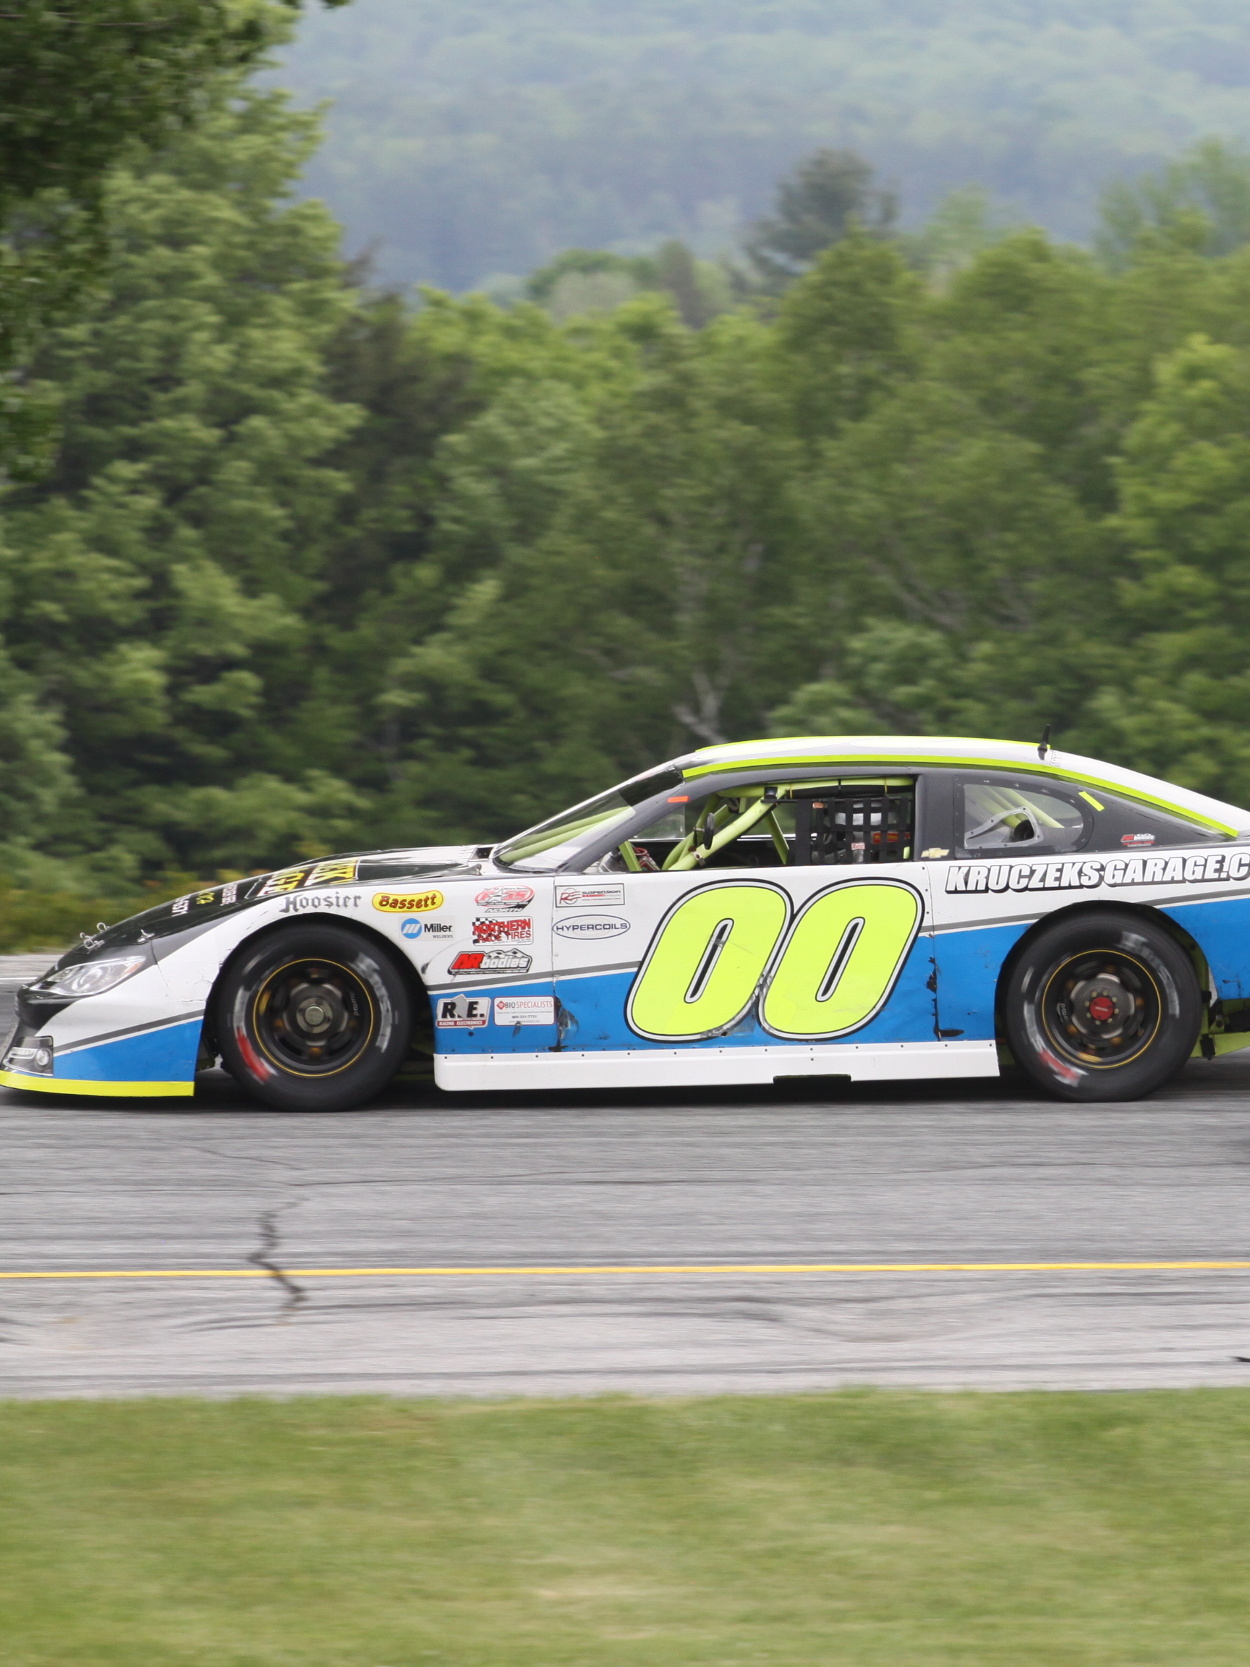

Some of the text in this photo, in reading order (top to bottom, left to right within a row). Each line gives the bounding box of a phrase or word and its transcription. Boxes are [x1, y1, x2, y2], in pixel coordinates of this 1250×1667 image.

[279, 891, 362, 912] Hoosier
[378, 893, 437, 909] Bassett
[424, 923, 453, 932] Miller
[473, 918, 531, 934] NORTHERN
[555, 922, 628, 931] HYPERCOILS
[504, 929, 531, 940] TIRES
[625, 879, 923, 1042] 00
